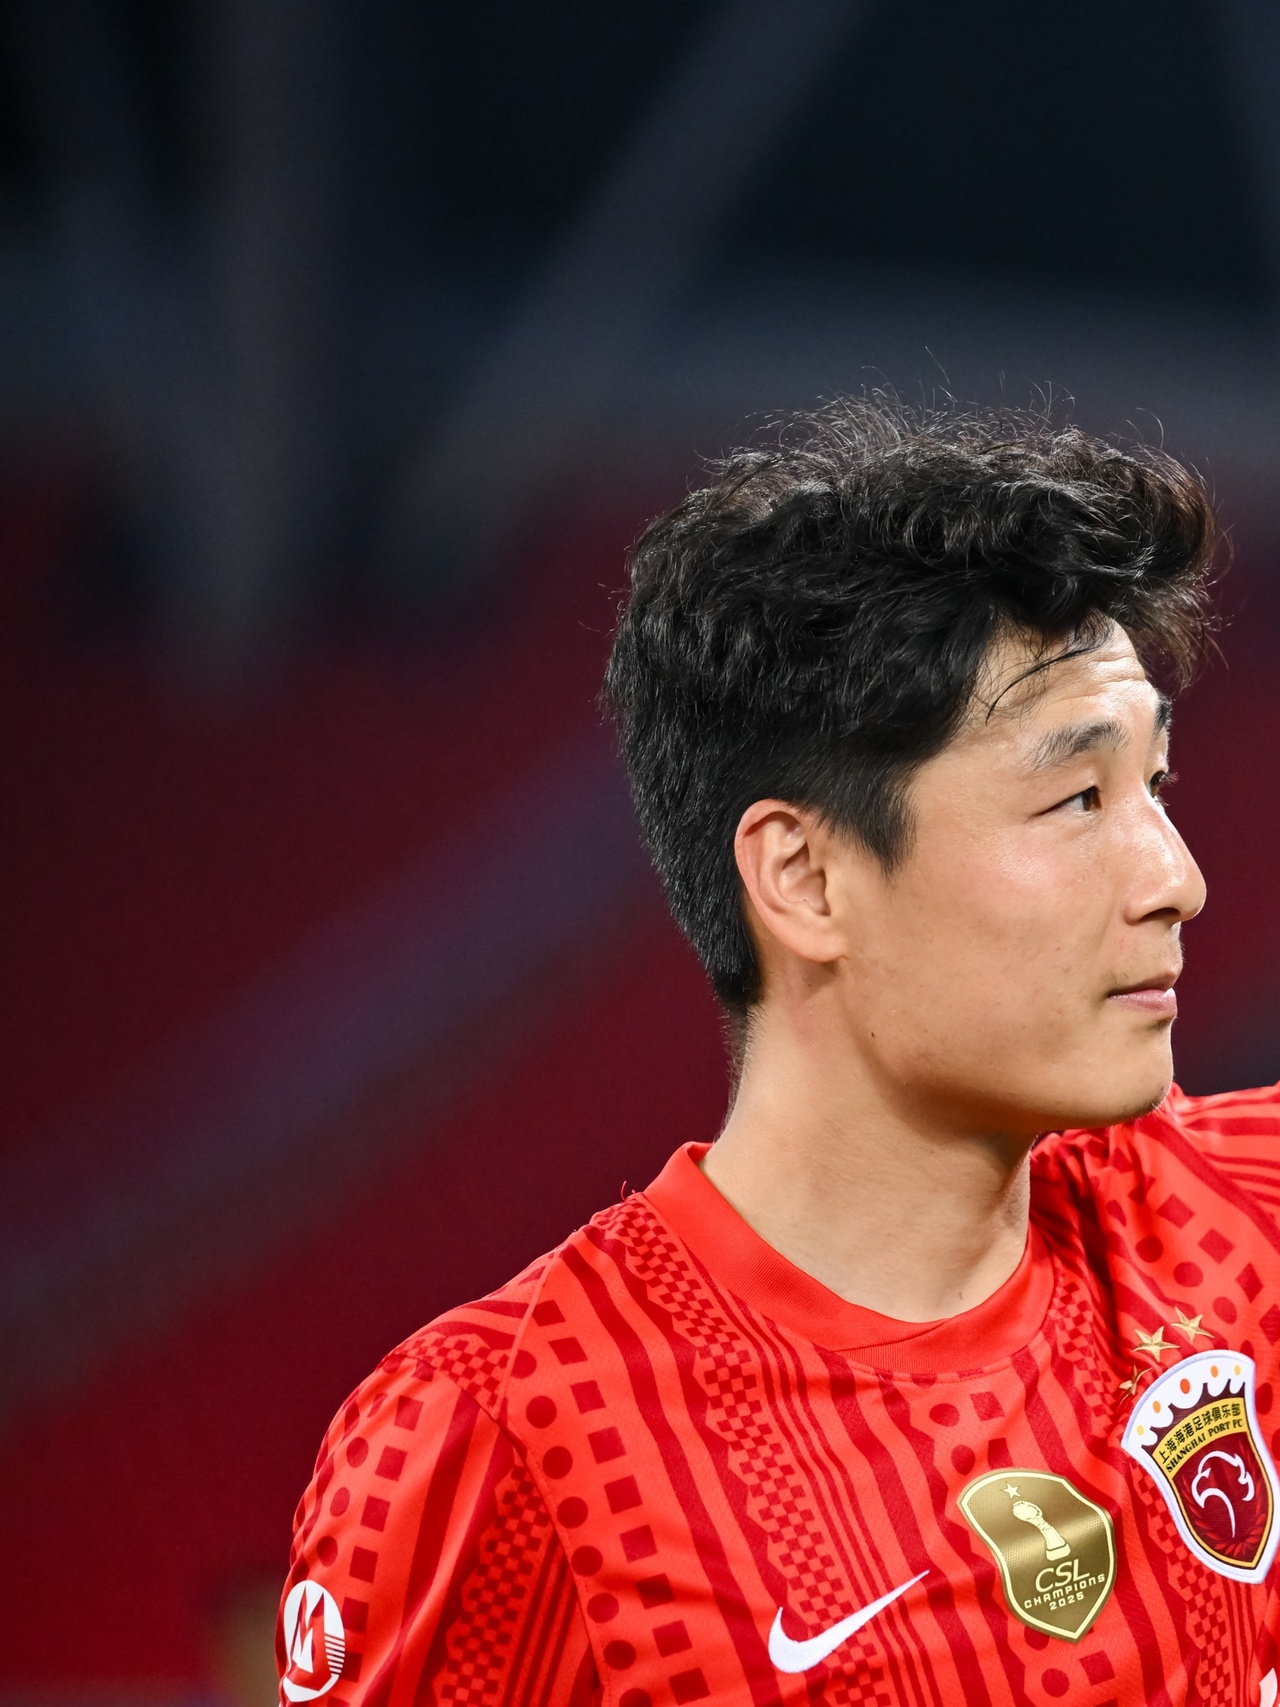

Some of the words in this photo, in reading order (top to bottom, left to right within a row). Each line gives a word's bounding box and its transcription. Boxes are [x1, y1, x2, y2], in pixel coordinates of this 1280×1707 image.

[1158, 1402, 1242, 1465] 上海海港足球俱乐部
[1165, 1432, 1207, 1473] SHANGHAI
[1207, 1421, 1231, 1437] PORT
[1232, 1418, 1244, 1429] FC
[1023, 1573, 1106, 1609] CHAMPIONS
[1035, 1558, 1091, 1593] CSL
[1049, 1591, 1085, 1611] 2025
